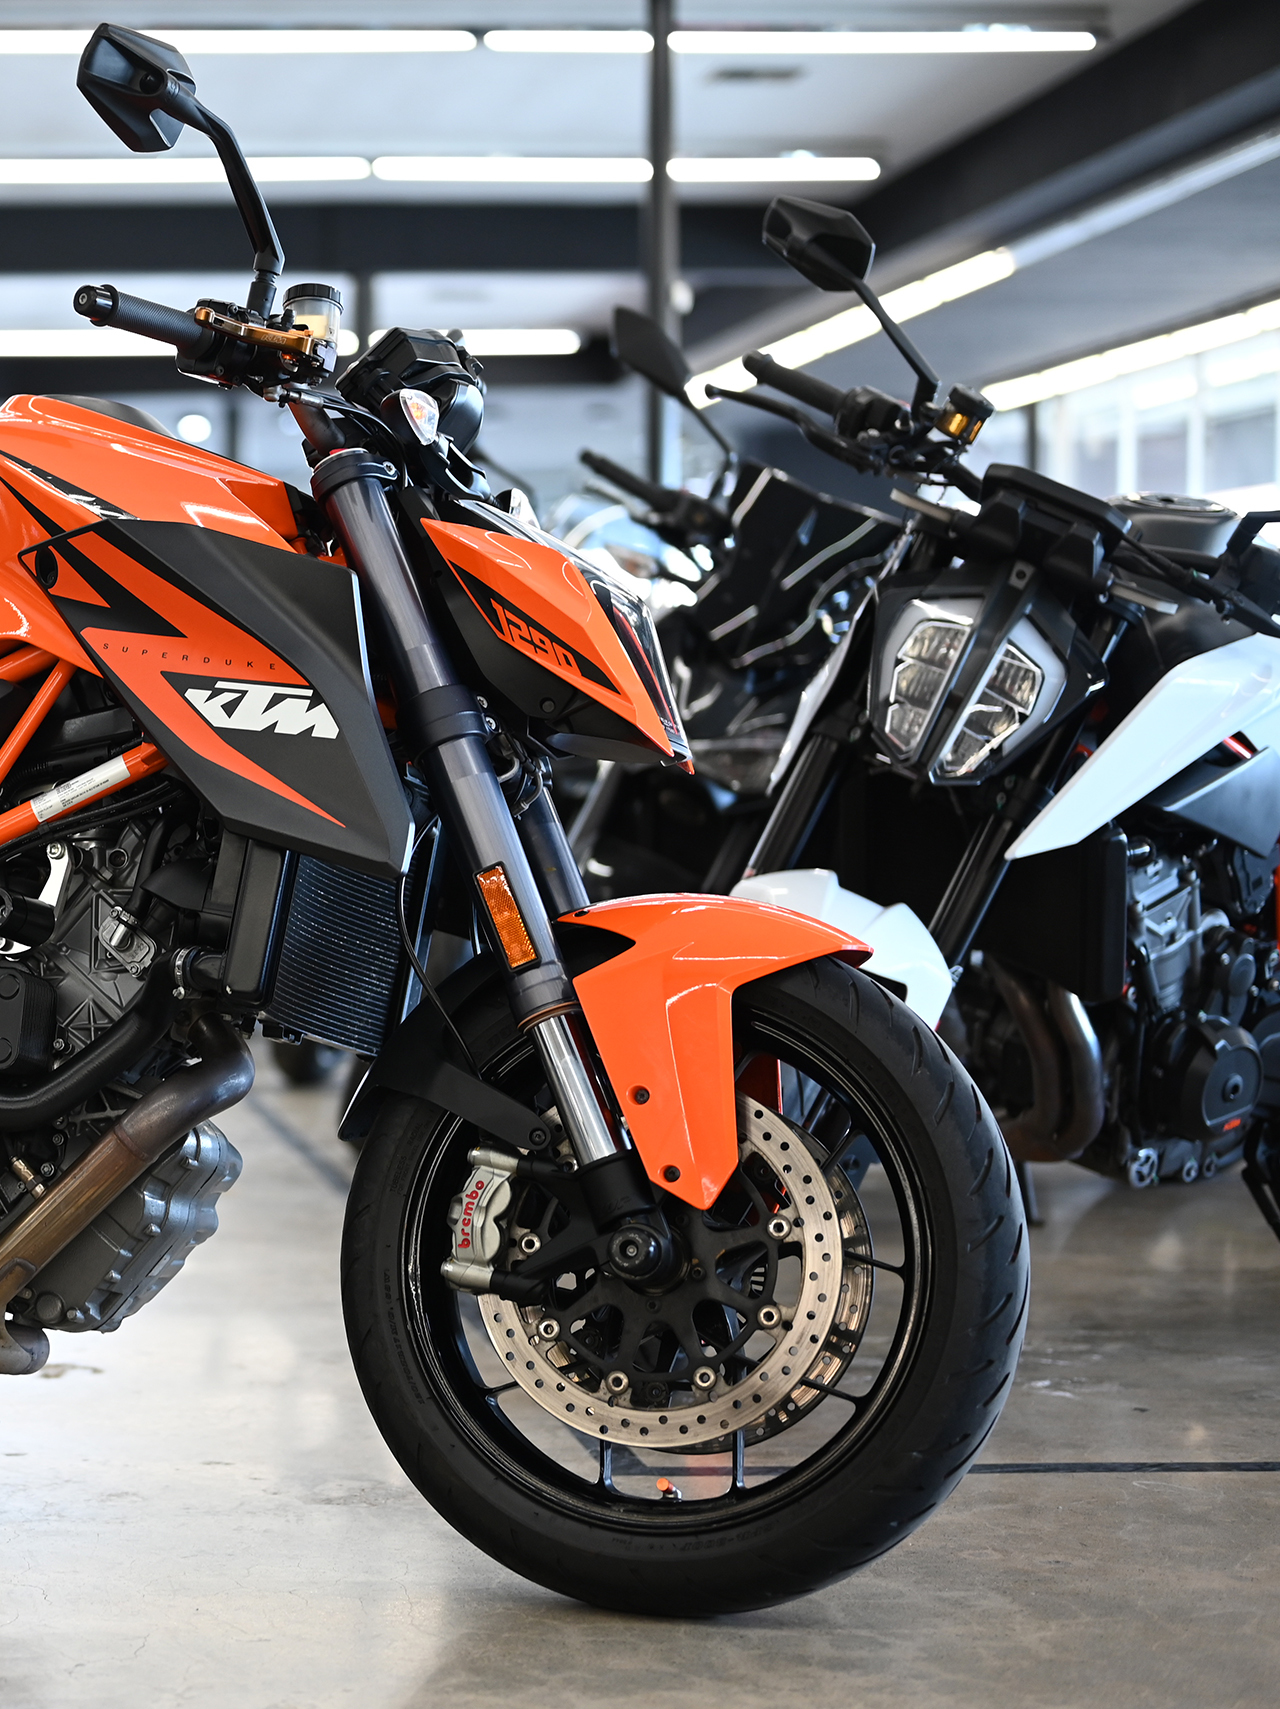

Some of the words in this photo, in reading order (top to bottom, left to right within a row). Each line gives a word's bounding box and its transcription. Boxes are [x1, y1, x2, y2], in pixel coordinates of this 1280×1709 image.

[489, 598, 582, 676] 1290
[184, 680, 340, 739] KTM
[458, 1180, 485, 1248] brembo
